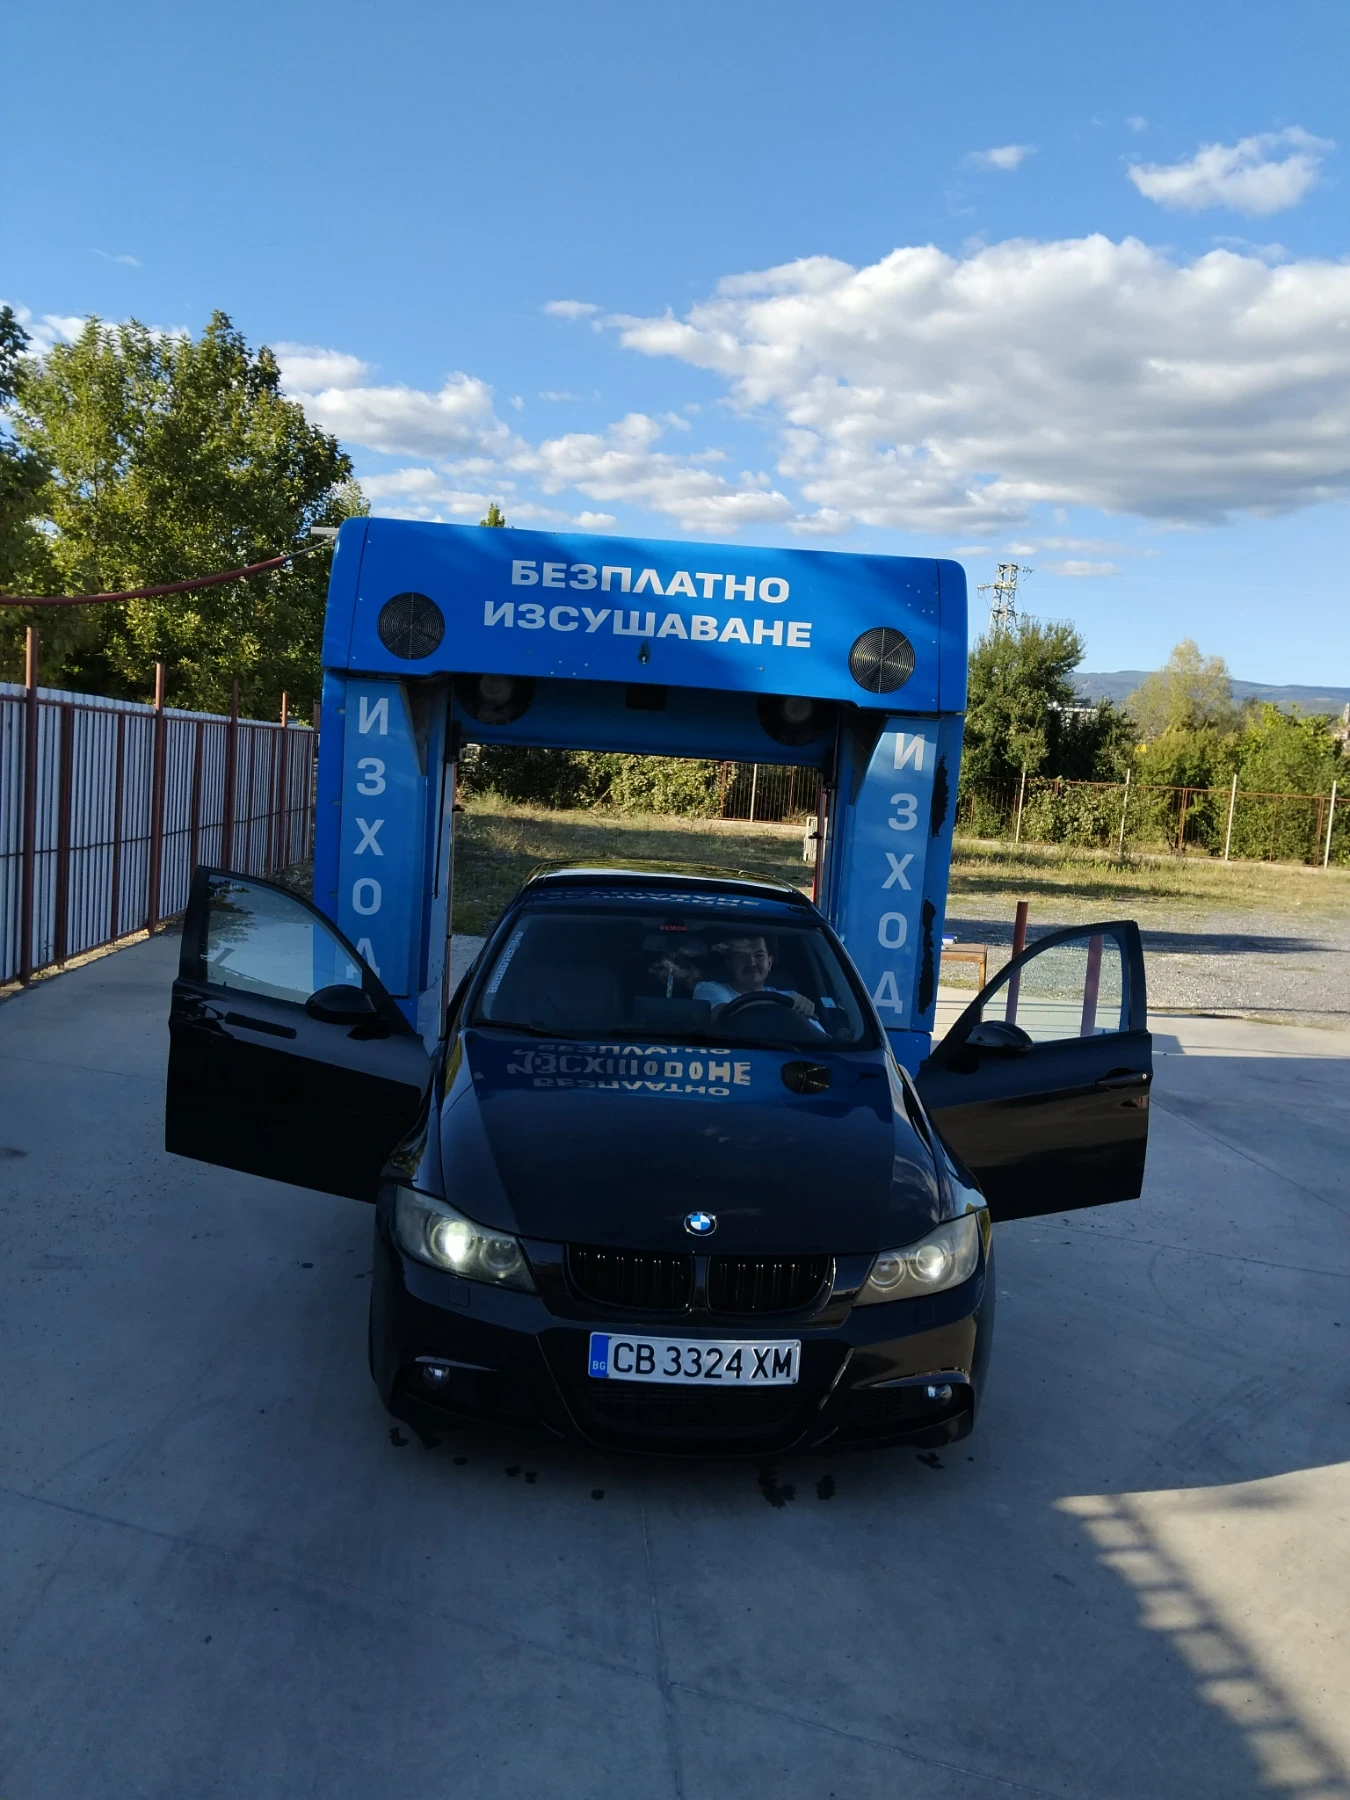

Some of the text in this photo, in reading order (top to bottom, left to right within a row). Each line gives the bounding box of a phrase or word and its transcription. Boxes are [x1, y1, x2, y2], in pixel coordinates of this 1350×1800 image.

[510, 559, 791, 604] БЕЗПЛАТНО
[483, 600, 813, 649] ИЗСУШАВАНЕ
[871, 732, 926, 1014] ИЗХОД
[592, 1360, 606, 1371] BG
[613, 1342, 792, 1379] CB 3324 XM
